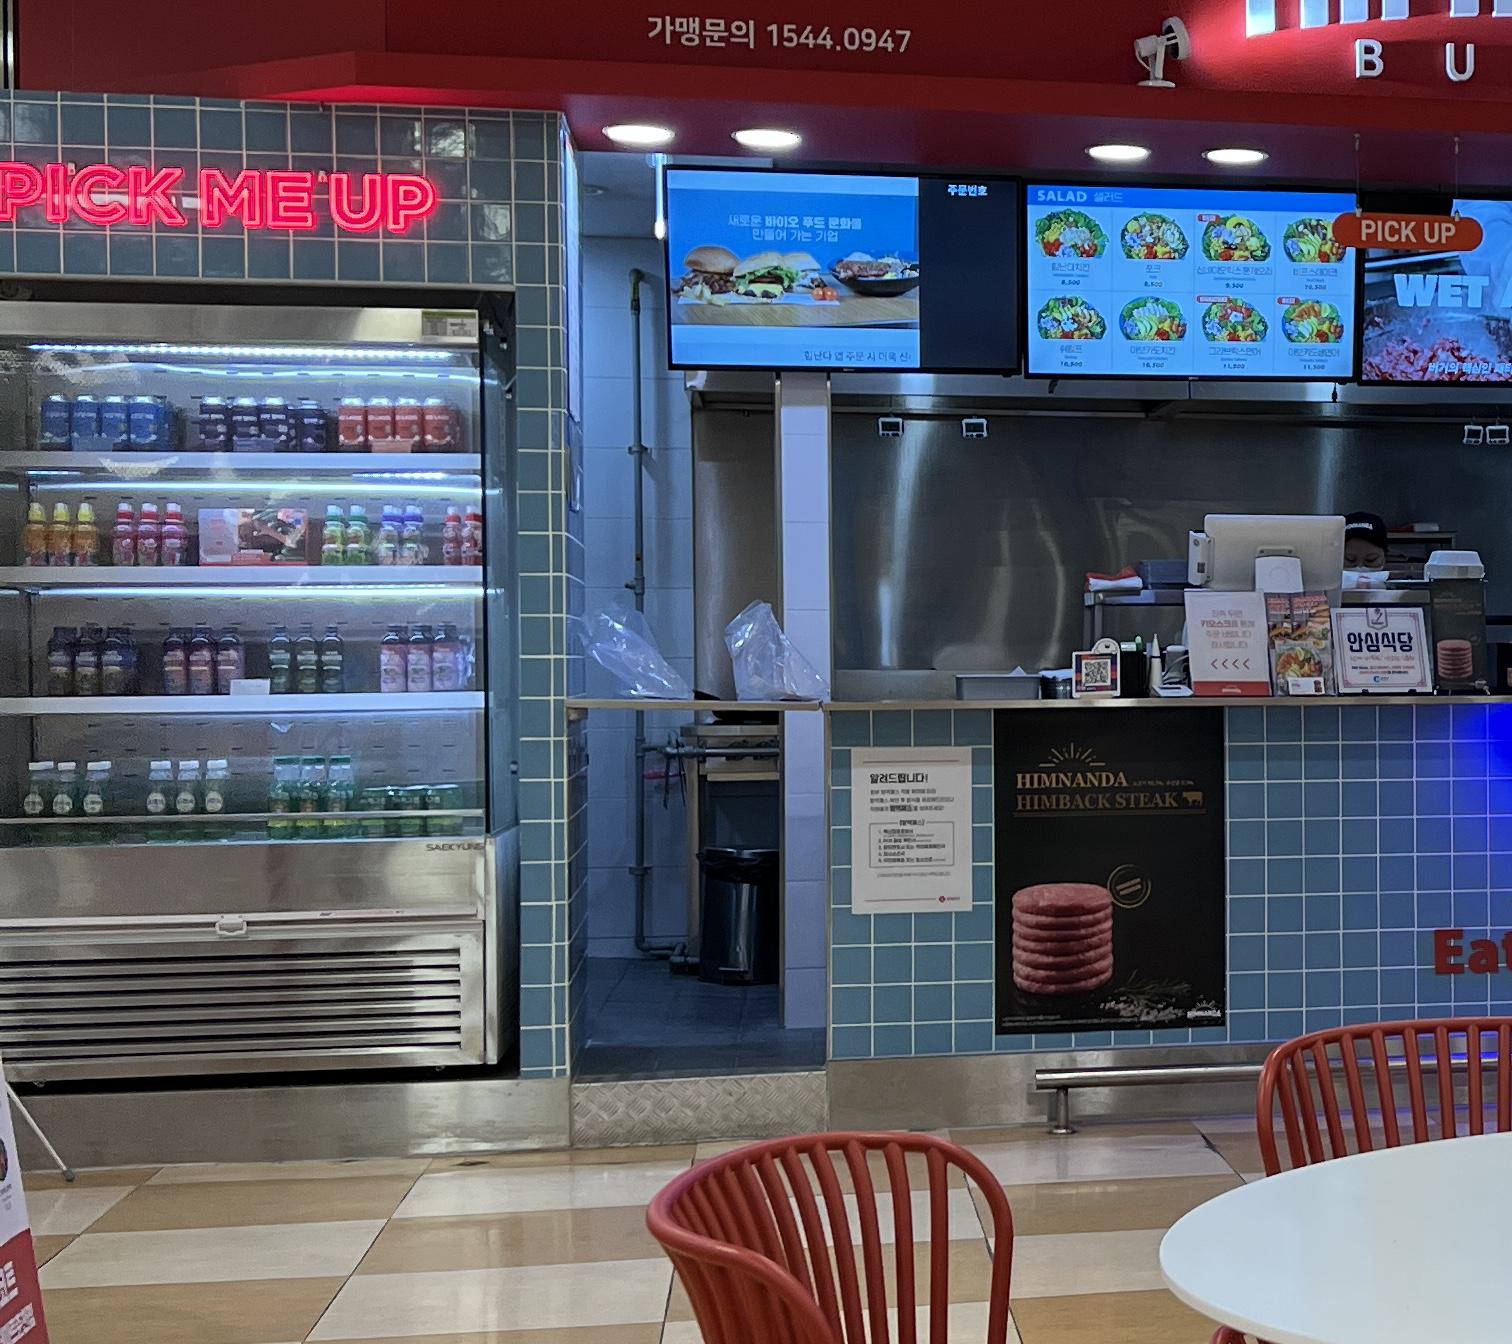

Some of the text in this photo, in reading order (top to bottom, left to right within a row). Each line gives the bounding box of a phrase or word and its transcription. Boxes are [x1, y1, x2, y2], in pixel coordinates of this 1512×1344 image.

[648, 15, 911, 53] 가맹문의 1544.0947
[0, 162, 439, 234] PICK ME UP
[947, 184, 988, 196] 주문번호
[1037, 190, 1124, 203] SALAD 샐러드
[764, 216, 799, 228] 바이오
[802, 217, 826, 229] 푸드
[1360, 220, 1456, 244] PICK UP
[1393, 273, 1490, 309] WET
[1347, 632, 1414, 653] 안심식당
[1016, 772, 1128, 789] HIMNANDA
[1016, 792, 1177, 810] HIMBACK STEAK
